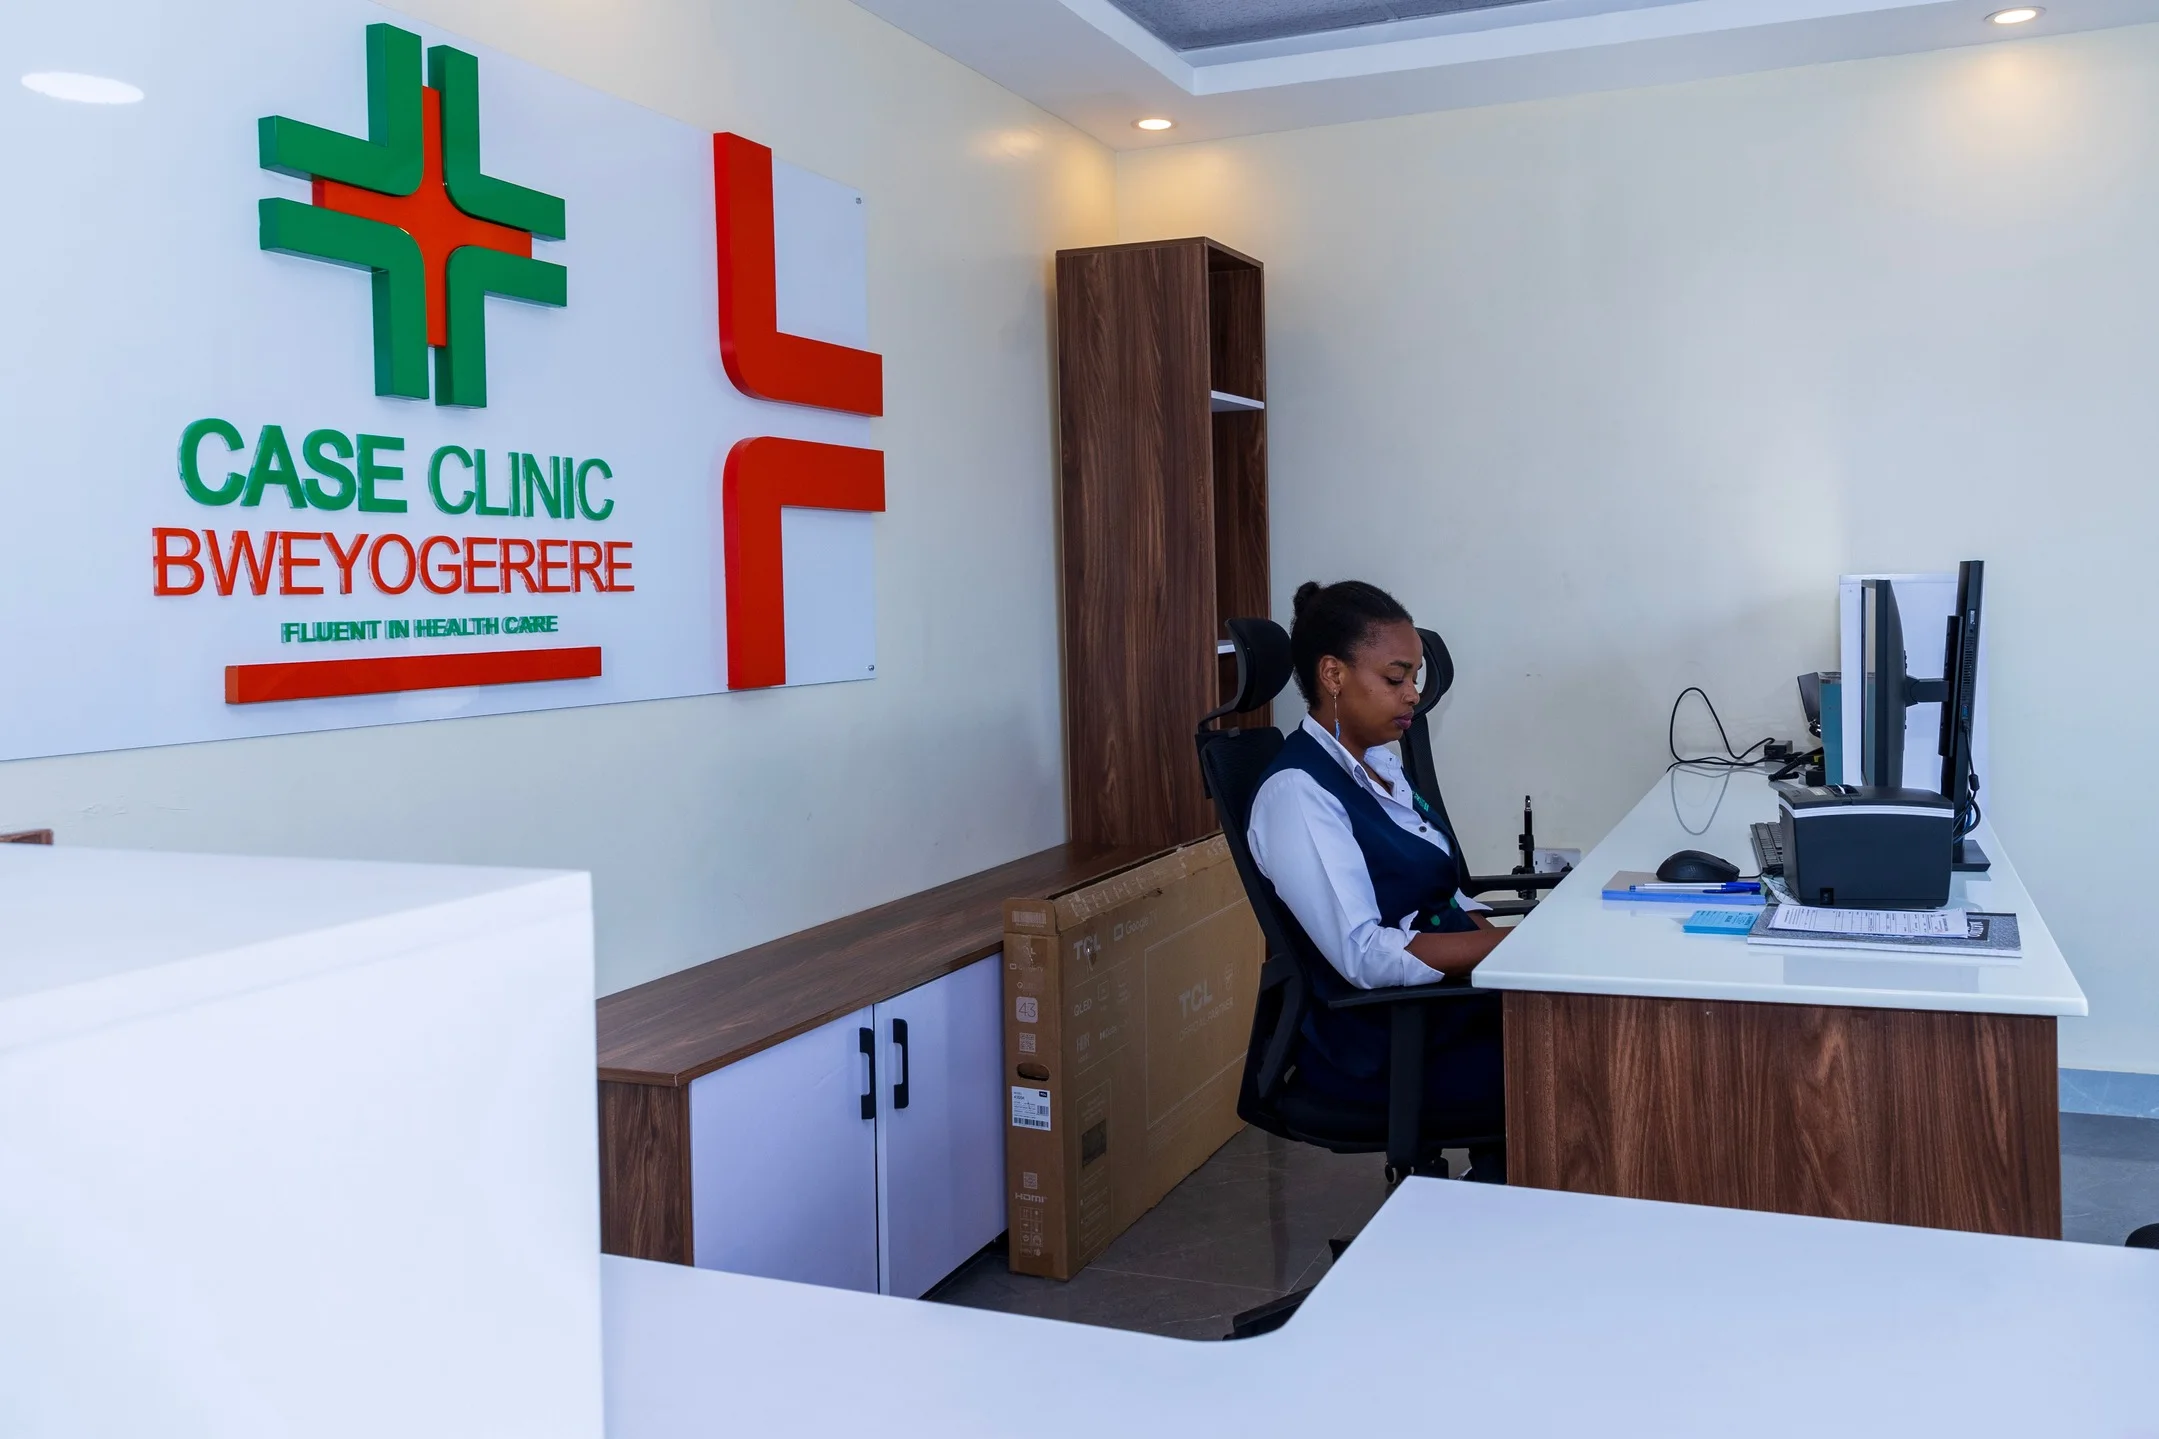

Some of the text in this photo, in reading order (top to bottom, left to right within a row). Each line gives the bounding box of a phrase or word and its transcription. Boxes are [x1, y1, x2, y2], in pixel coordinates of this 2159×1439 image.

[178, 418, 615, 521] CASE CLINIC
[152, 527, 635, 597] BWEYOGERERE
[281, 615, 558, 643] FLUENT IN HEALTH CARE
[1073, 932, 1101, 960] TCL
[1019, 1002, 1036, 1018] 43
[1179, 979, 1213, 1019] TCL
